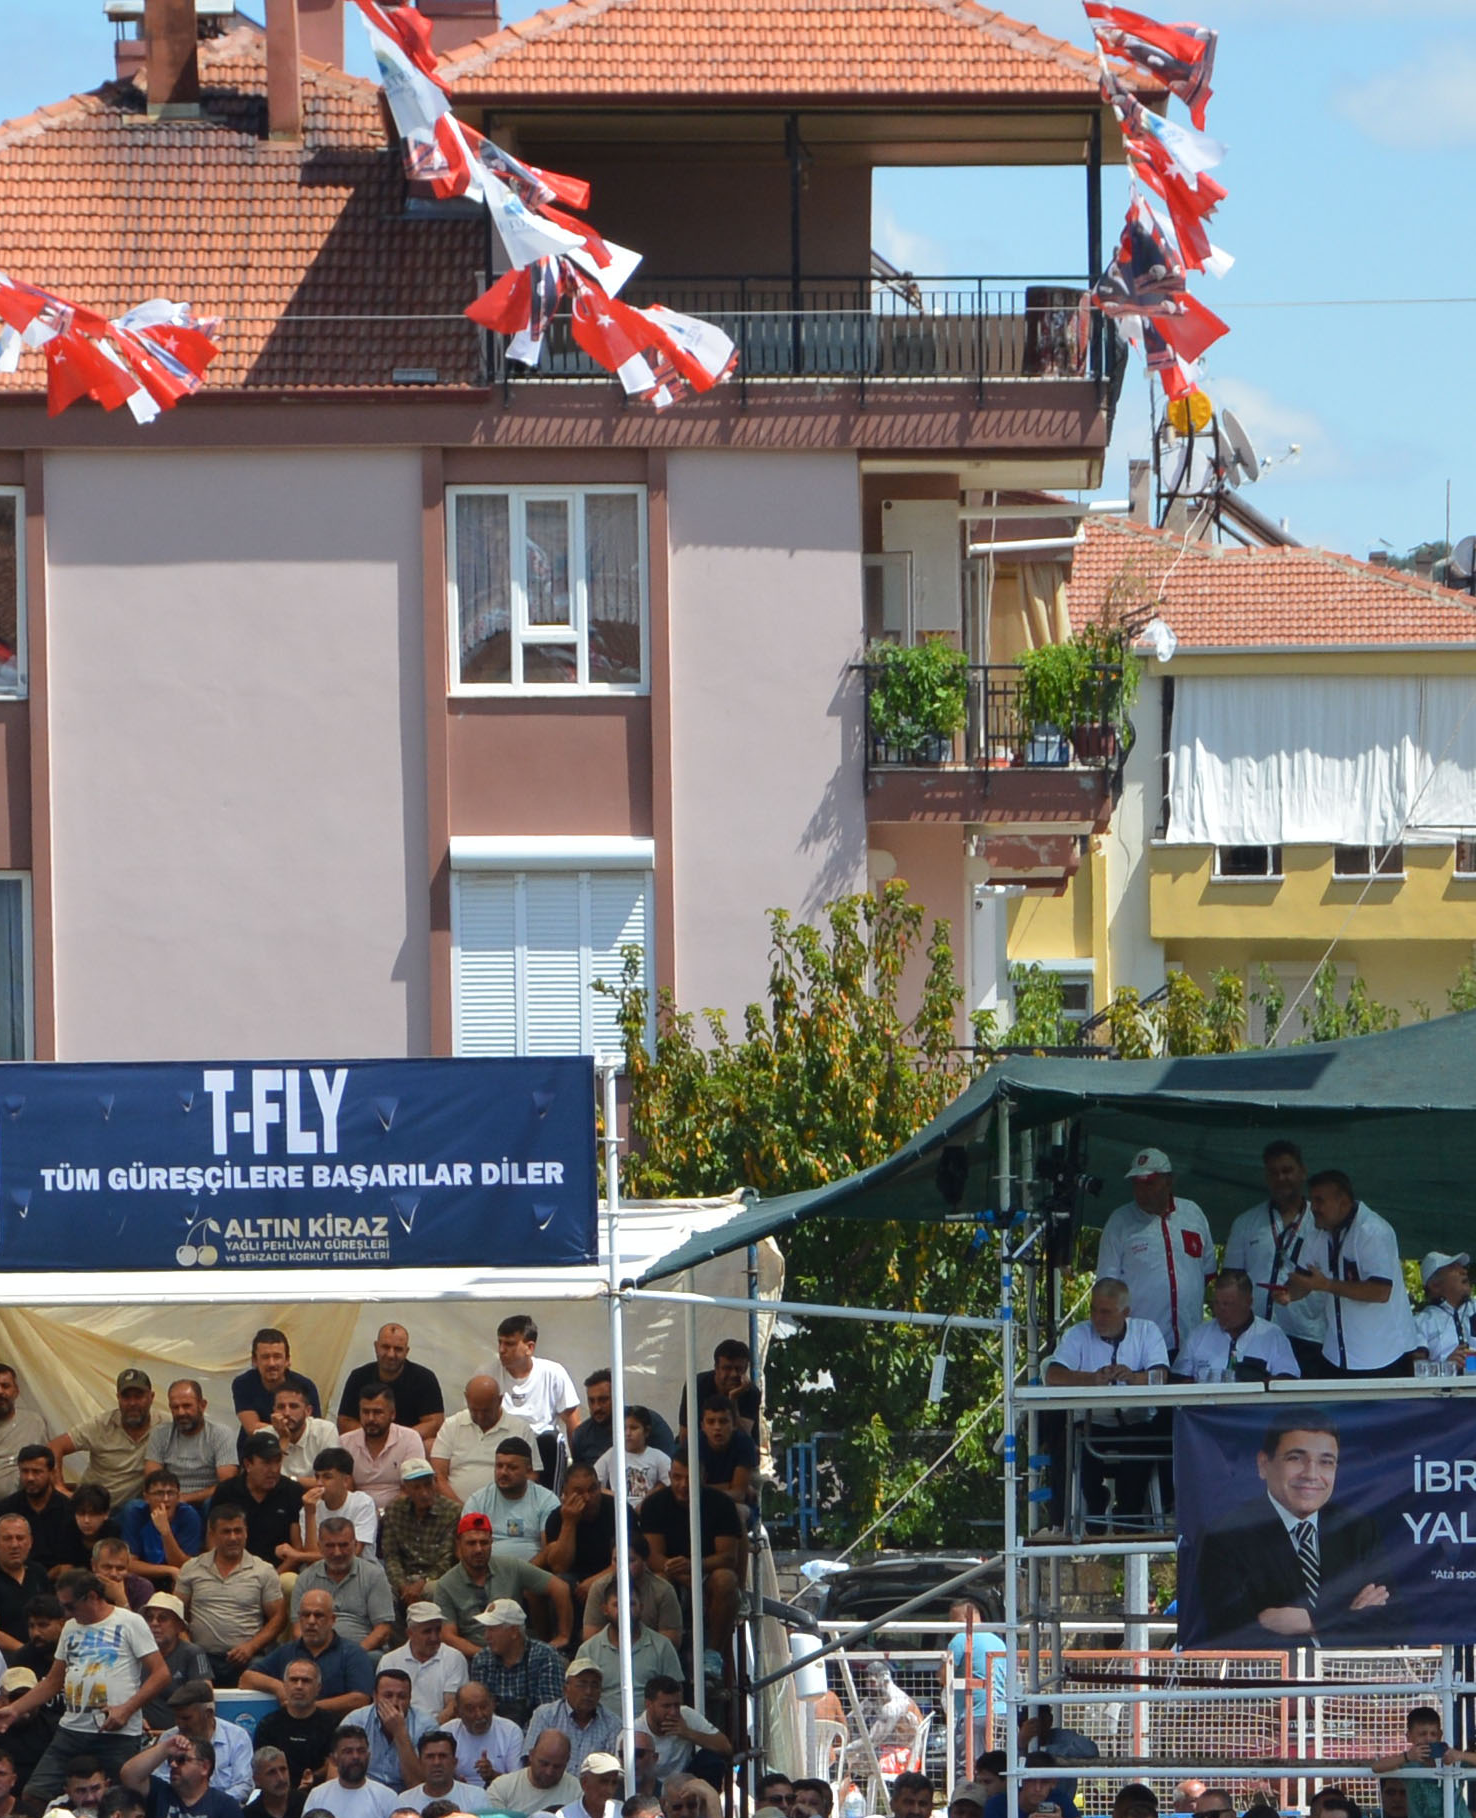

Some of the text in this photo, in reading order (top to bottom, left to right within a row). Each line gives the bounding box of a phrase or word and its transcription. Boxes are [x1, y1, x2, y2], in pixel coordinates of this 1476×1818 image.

[40, 1156, 565, 1197] TÜM GÜREŞÇİLERE BAŞARILAR DİLER
[224, 1212, 389, 1239] ALTIN KİRAZ
[225, 1236, 390, 1251] YAĞLI PEHLİVAN GÜREŞLERİ
